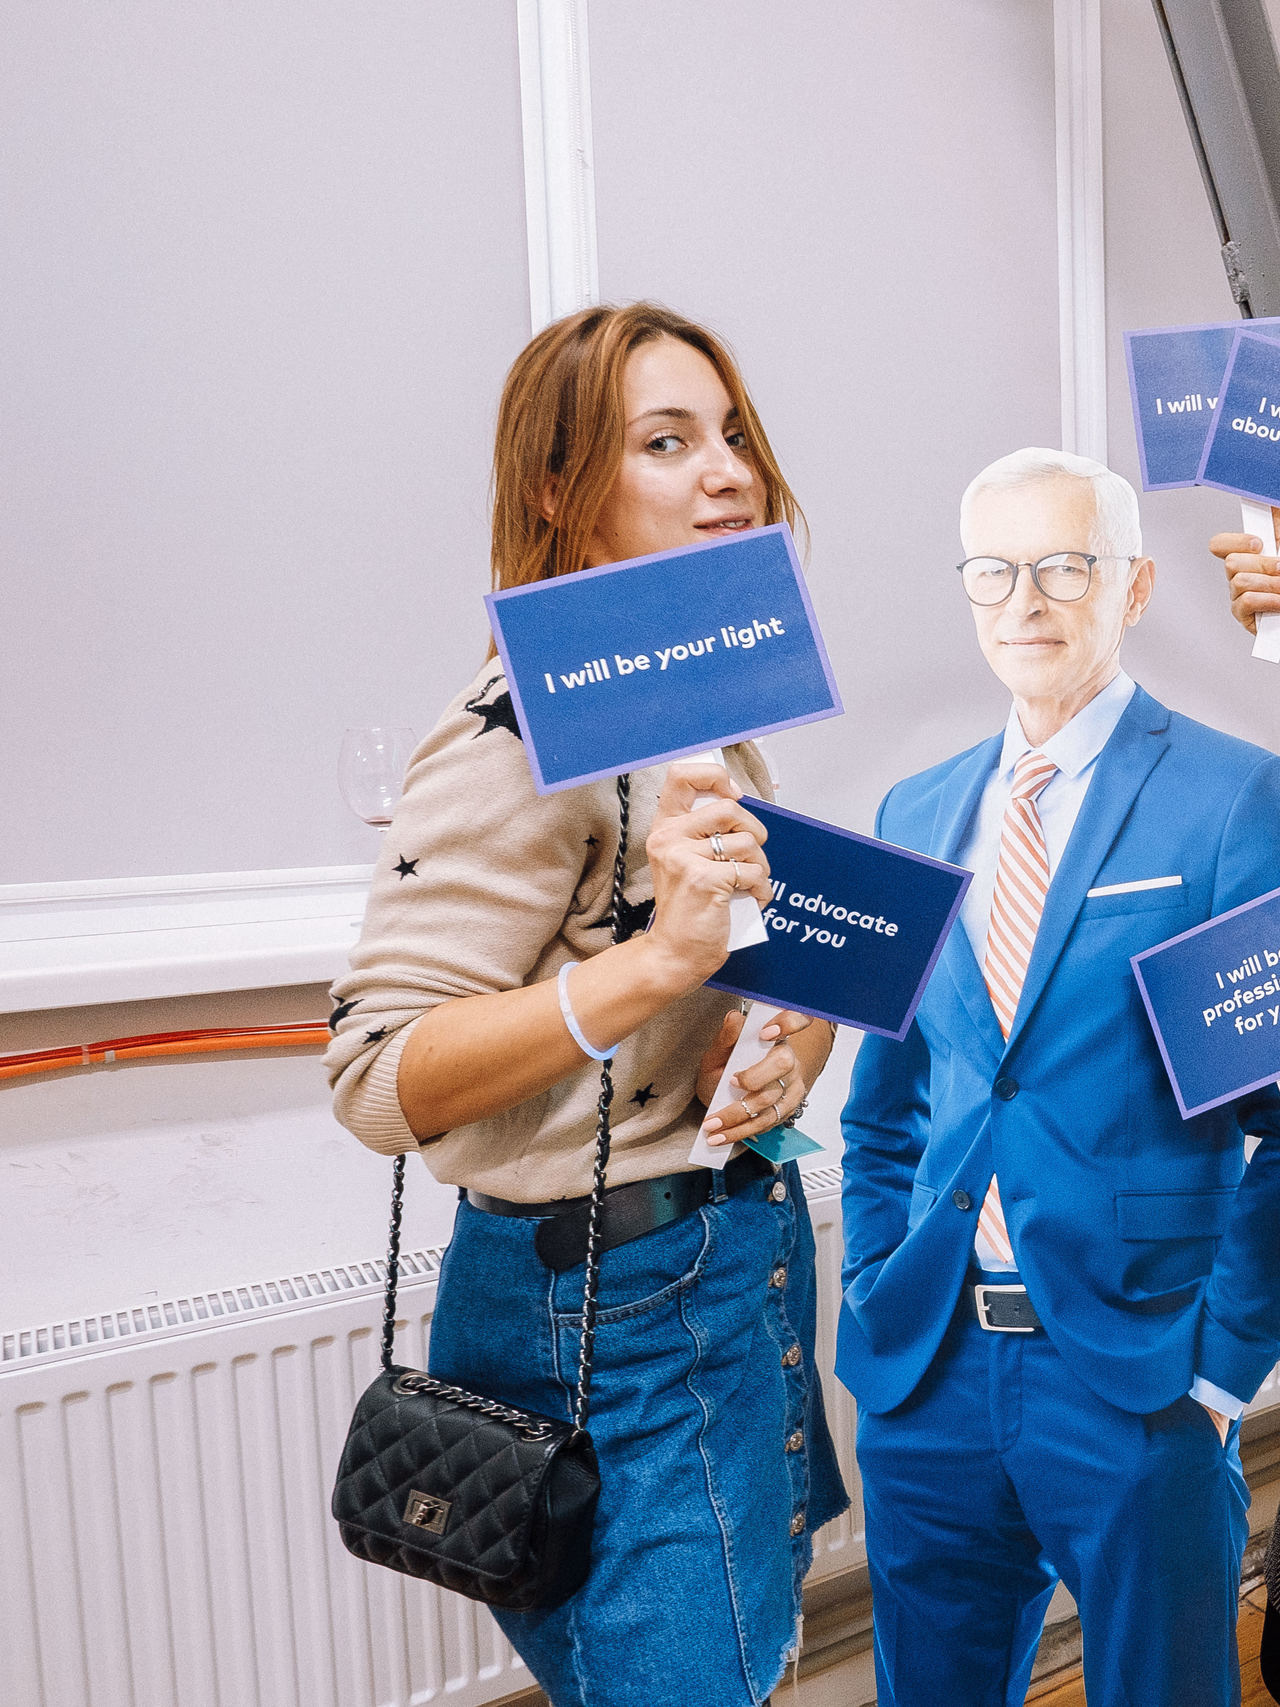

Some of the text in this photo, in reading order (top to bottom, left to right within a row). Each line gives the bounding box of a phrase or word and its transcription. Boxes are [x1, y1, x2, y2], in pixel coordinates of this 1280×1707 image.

[1156, 398, 1163, 415] I
[1166, 393, 1203, 414] will
[1258, 397, 1267, 413] I
[544, 617, 786, 694] I will be your light
[763, 907, 847, 949] for you
[788, 892, 899, 937] advocate
[1215, 972, 1225, 989] I
[1226, 954, 1263, 984] will
[1234, 1012, 1264, 1035] for
